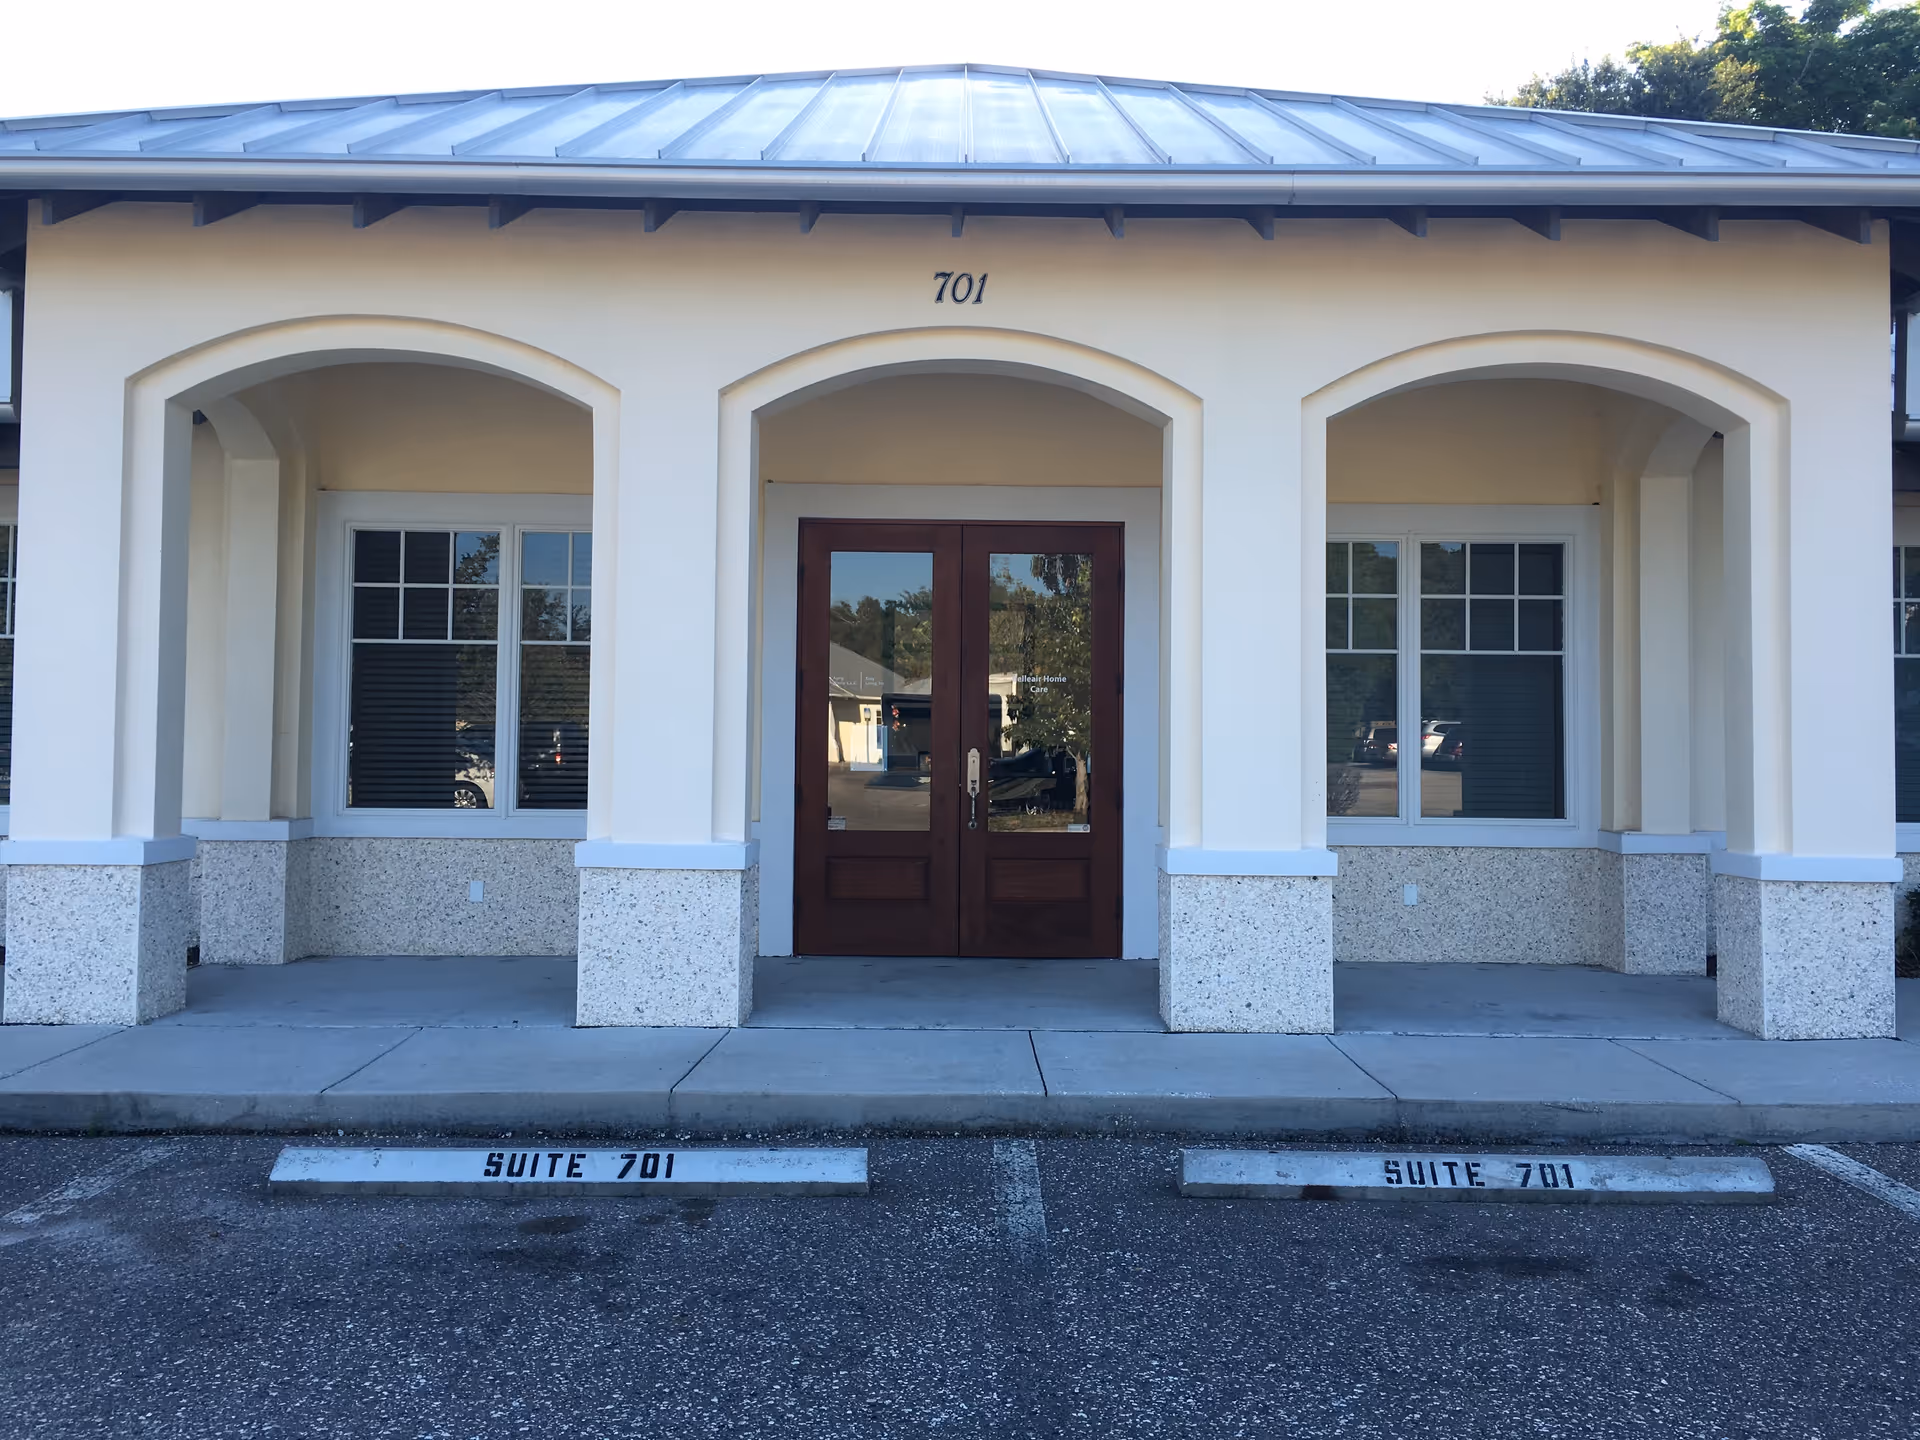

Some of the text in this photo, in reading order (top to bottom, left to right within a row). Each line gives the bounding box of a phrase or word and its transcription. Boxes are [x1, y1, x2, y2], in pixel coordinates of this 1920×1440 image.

[933, 271, 988, 305] 701
[1012, 674, 1067, 683] elleair Home
[1030, 685, 1049, 693] Care
[483, 1152, 675, 1179] SUITE 701
[1384, 1159, 1575, 1189] SUITE 701
